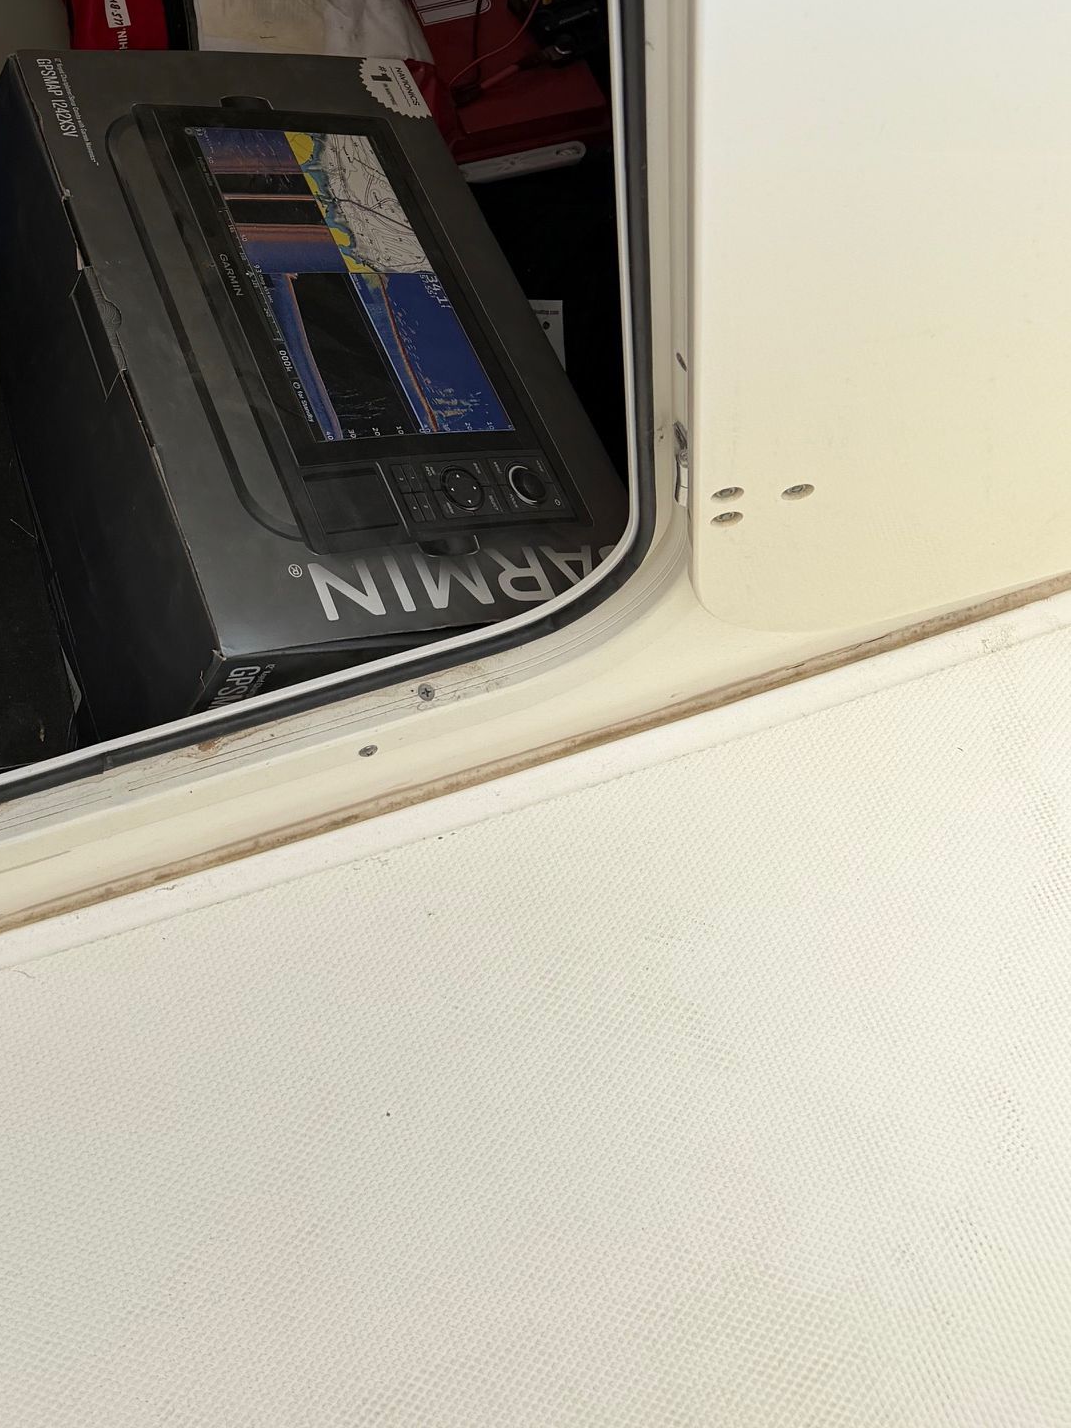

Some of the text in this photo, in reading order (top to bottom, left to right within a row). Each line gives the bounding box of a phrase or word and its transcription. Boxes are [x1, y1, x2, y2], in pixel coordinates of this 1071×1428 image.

[370, 65, 393, 82] #1
[395, 67, 421, 106] NAVIONICS
[36, 58, 79, 138] GPSMAP 1242XSV
[219, 253, 245, 298] GARMIN
[308, 539, 623, 621] ARMIN
